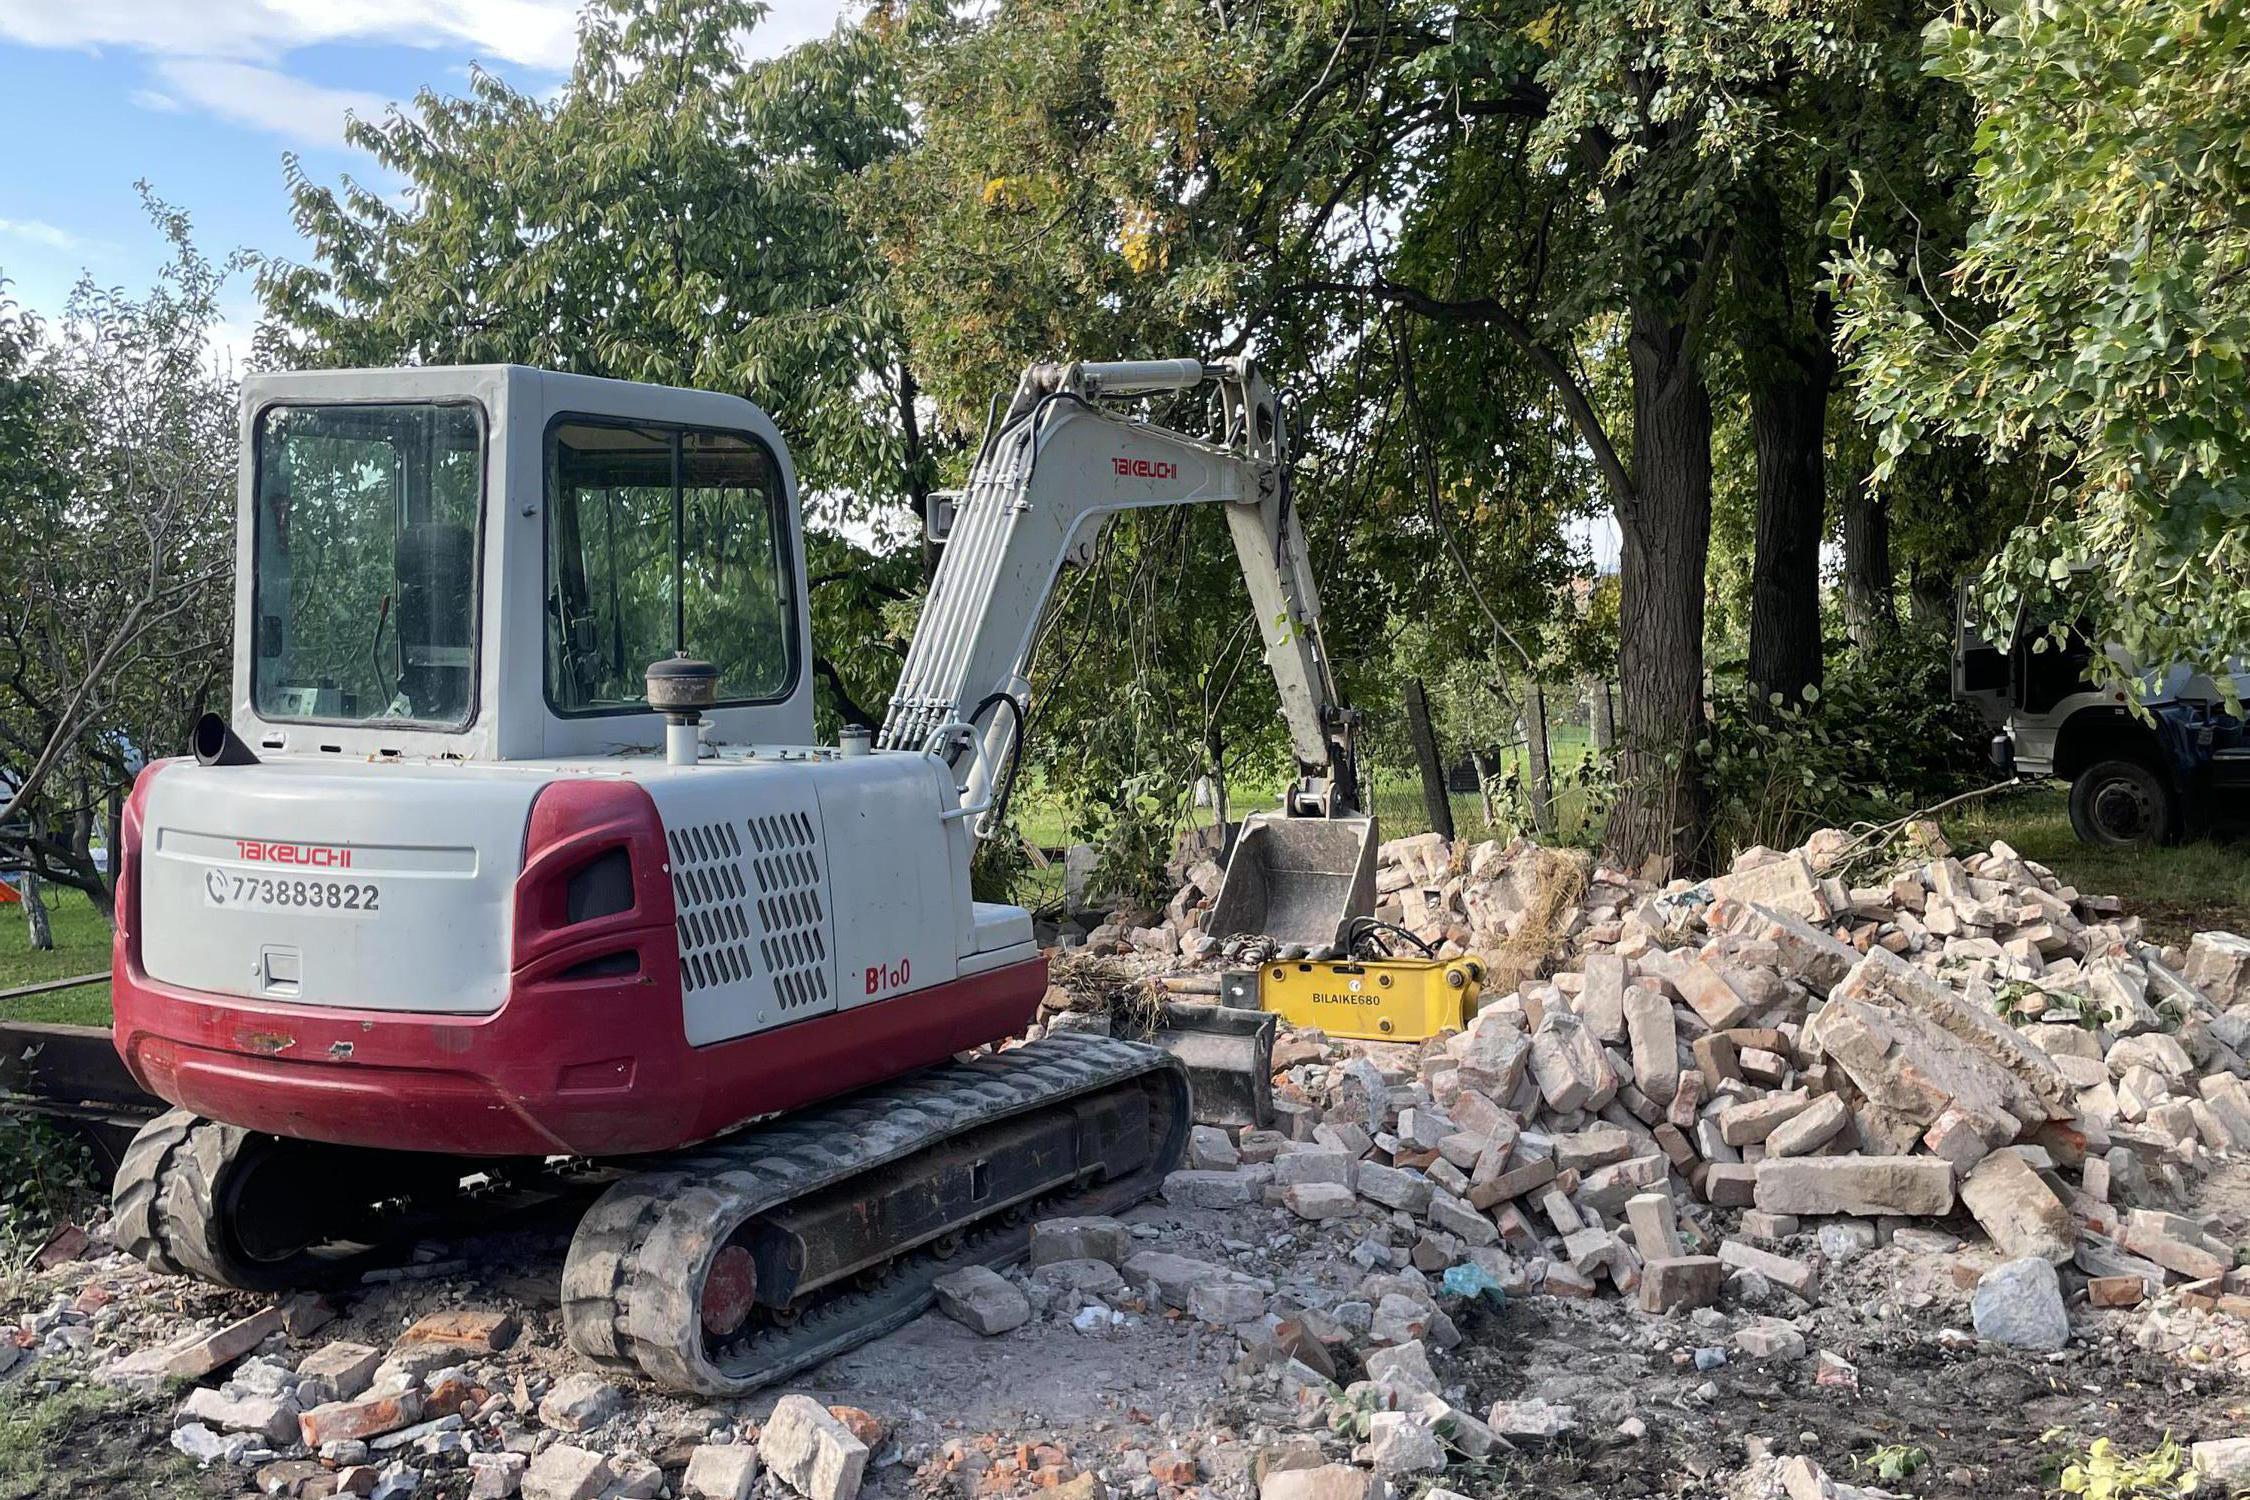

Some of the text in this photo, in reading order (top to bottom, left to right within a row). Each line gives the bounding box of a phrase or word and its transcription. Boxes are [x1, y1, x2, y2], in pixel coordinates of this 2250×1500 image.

[1111, 457, 1177, 480] TAKEUCHI
[236, 840, 351, 868] TAKEUCHI
[233, 877, 379, 911] 773883822
[1312, 993, 1380, 1006] BILAIKE680
